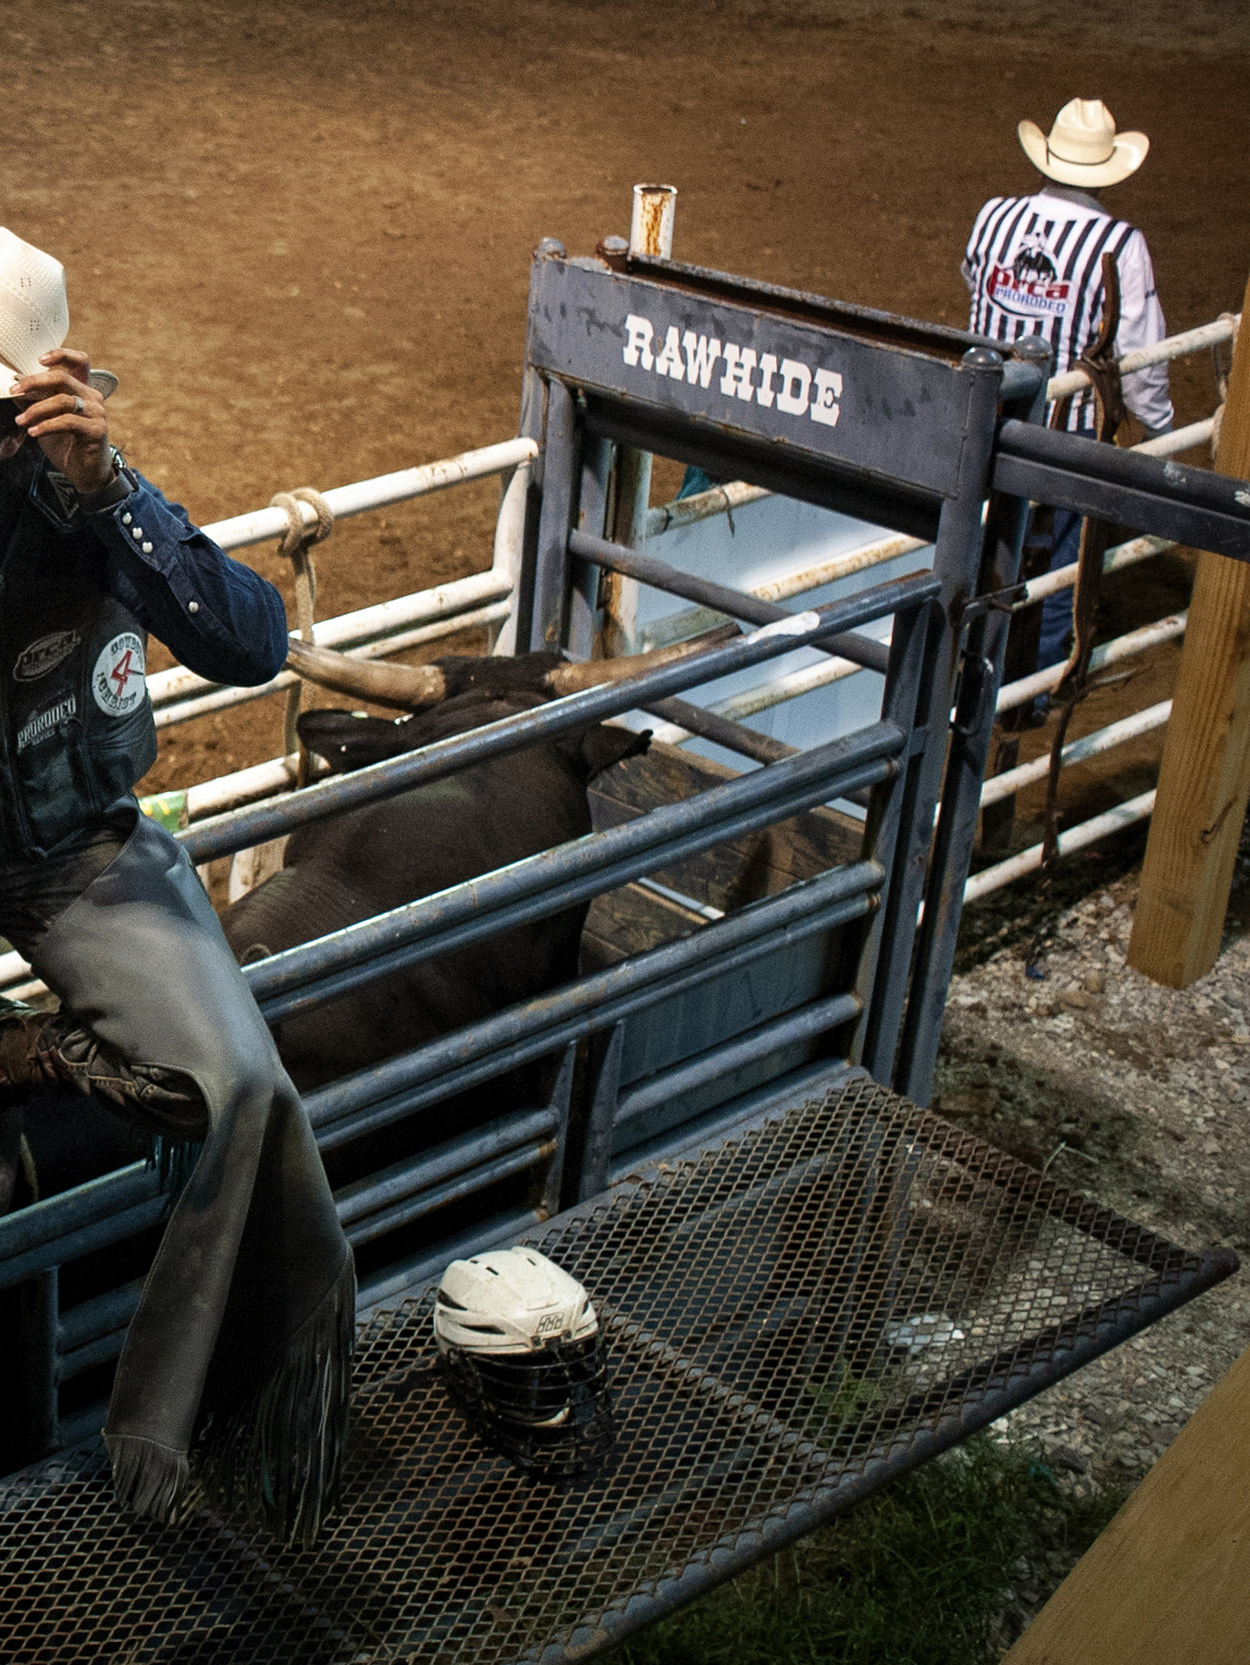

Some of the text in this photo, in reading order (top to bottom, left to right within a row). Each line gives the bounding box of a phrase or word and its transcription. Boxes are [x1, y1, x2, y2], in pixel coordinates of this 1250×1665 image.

[623, 314, 843, 428] RAWHIDE
[111, 649, 136, 696] 4
[17, 694, 76, 754] PRORODEO
